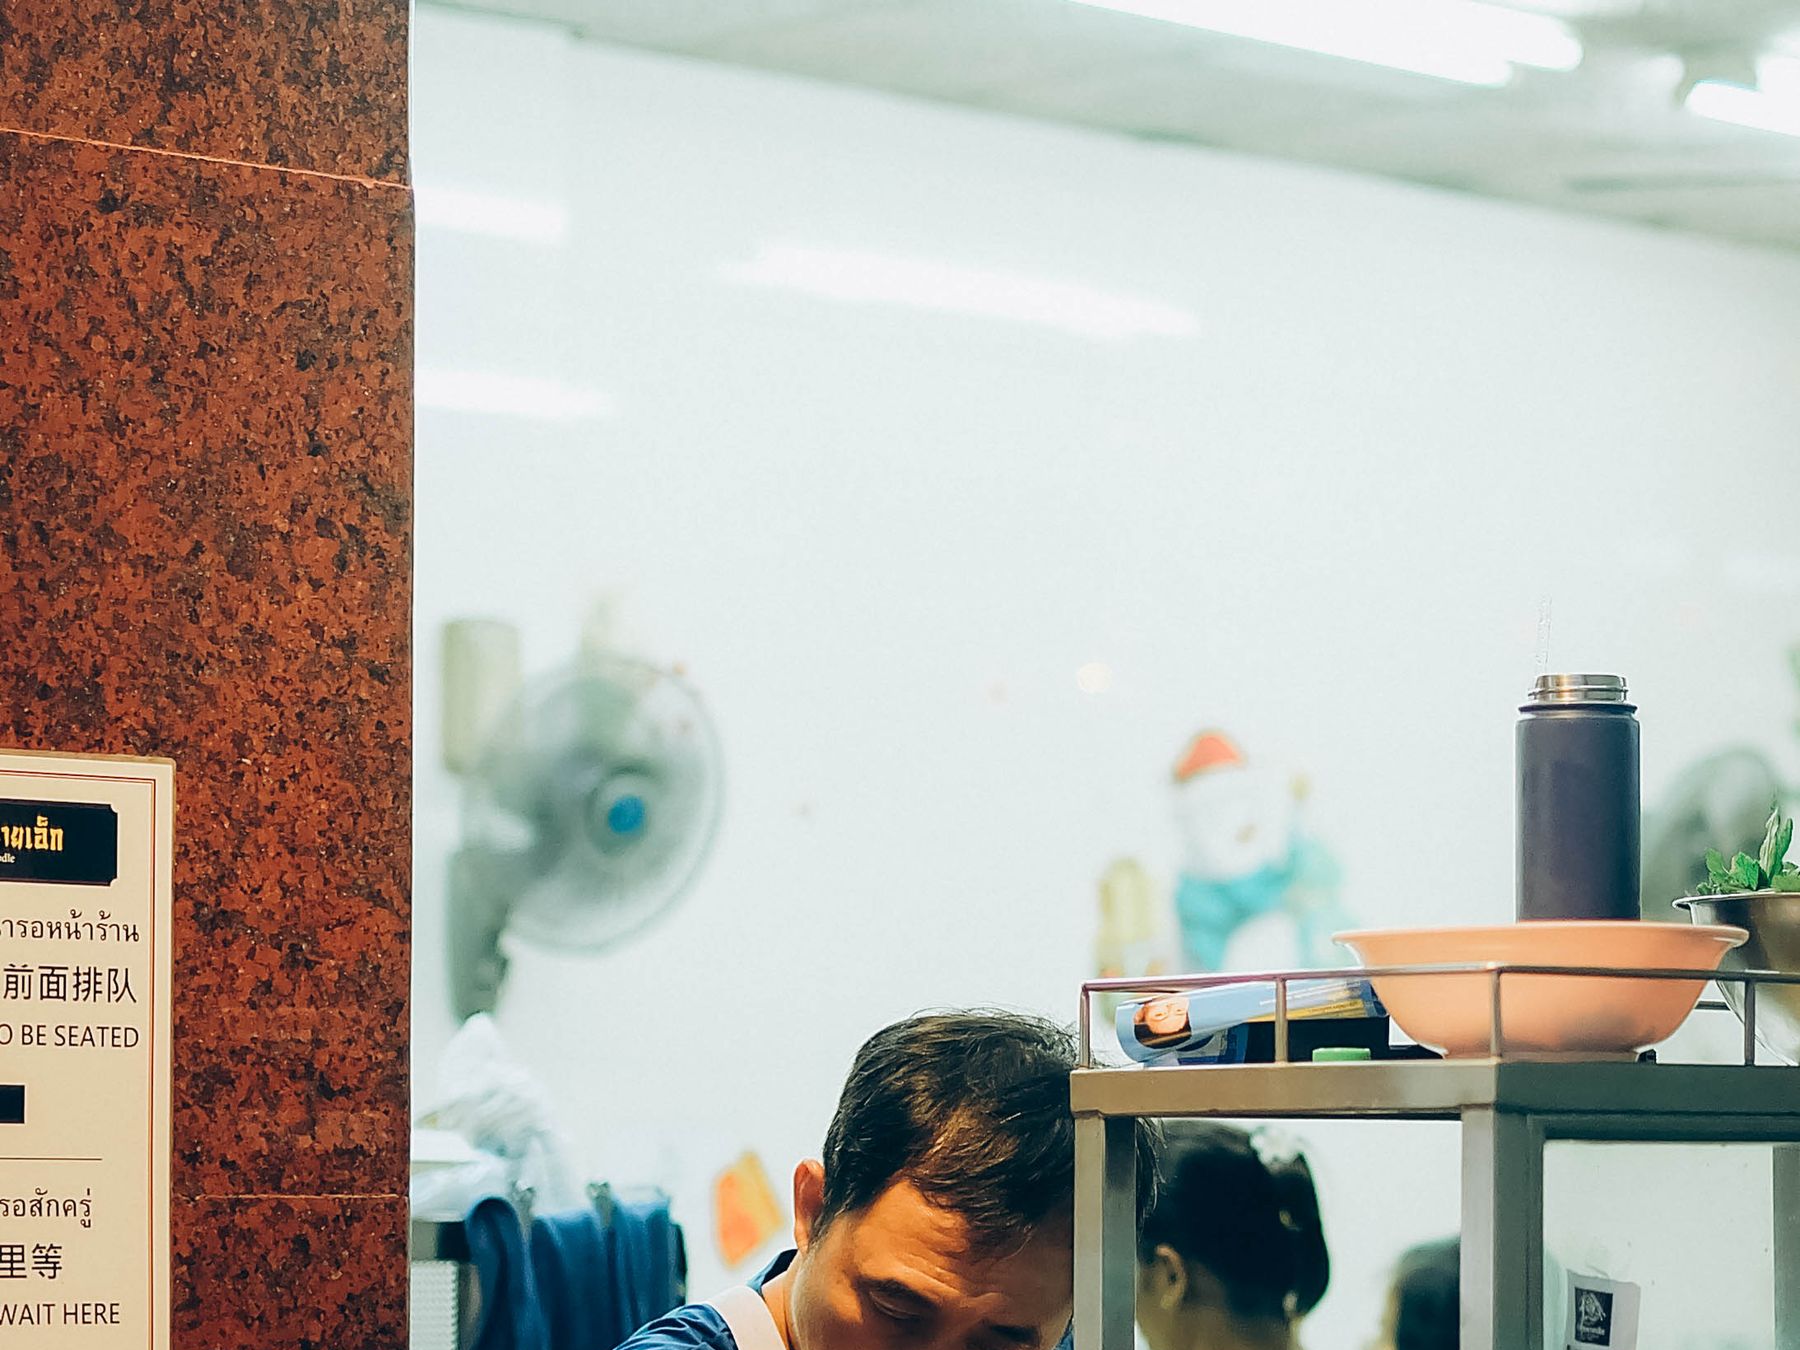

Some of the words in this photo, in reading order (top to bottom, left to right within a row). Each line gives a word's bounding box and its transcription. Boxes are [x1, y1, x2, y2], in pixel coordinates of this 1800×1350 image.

[0, 908, 140, 942] ารอหน้าร้าน
[3, 963, 137, 1003] 前面排队
[21, 1024, 47, 1046] BE
[54, 1025, 139, 1048] SEATED
[0, 1303, 55, 1325] WAIT
[63, 1303, 120, 1325] HERE
